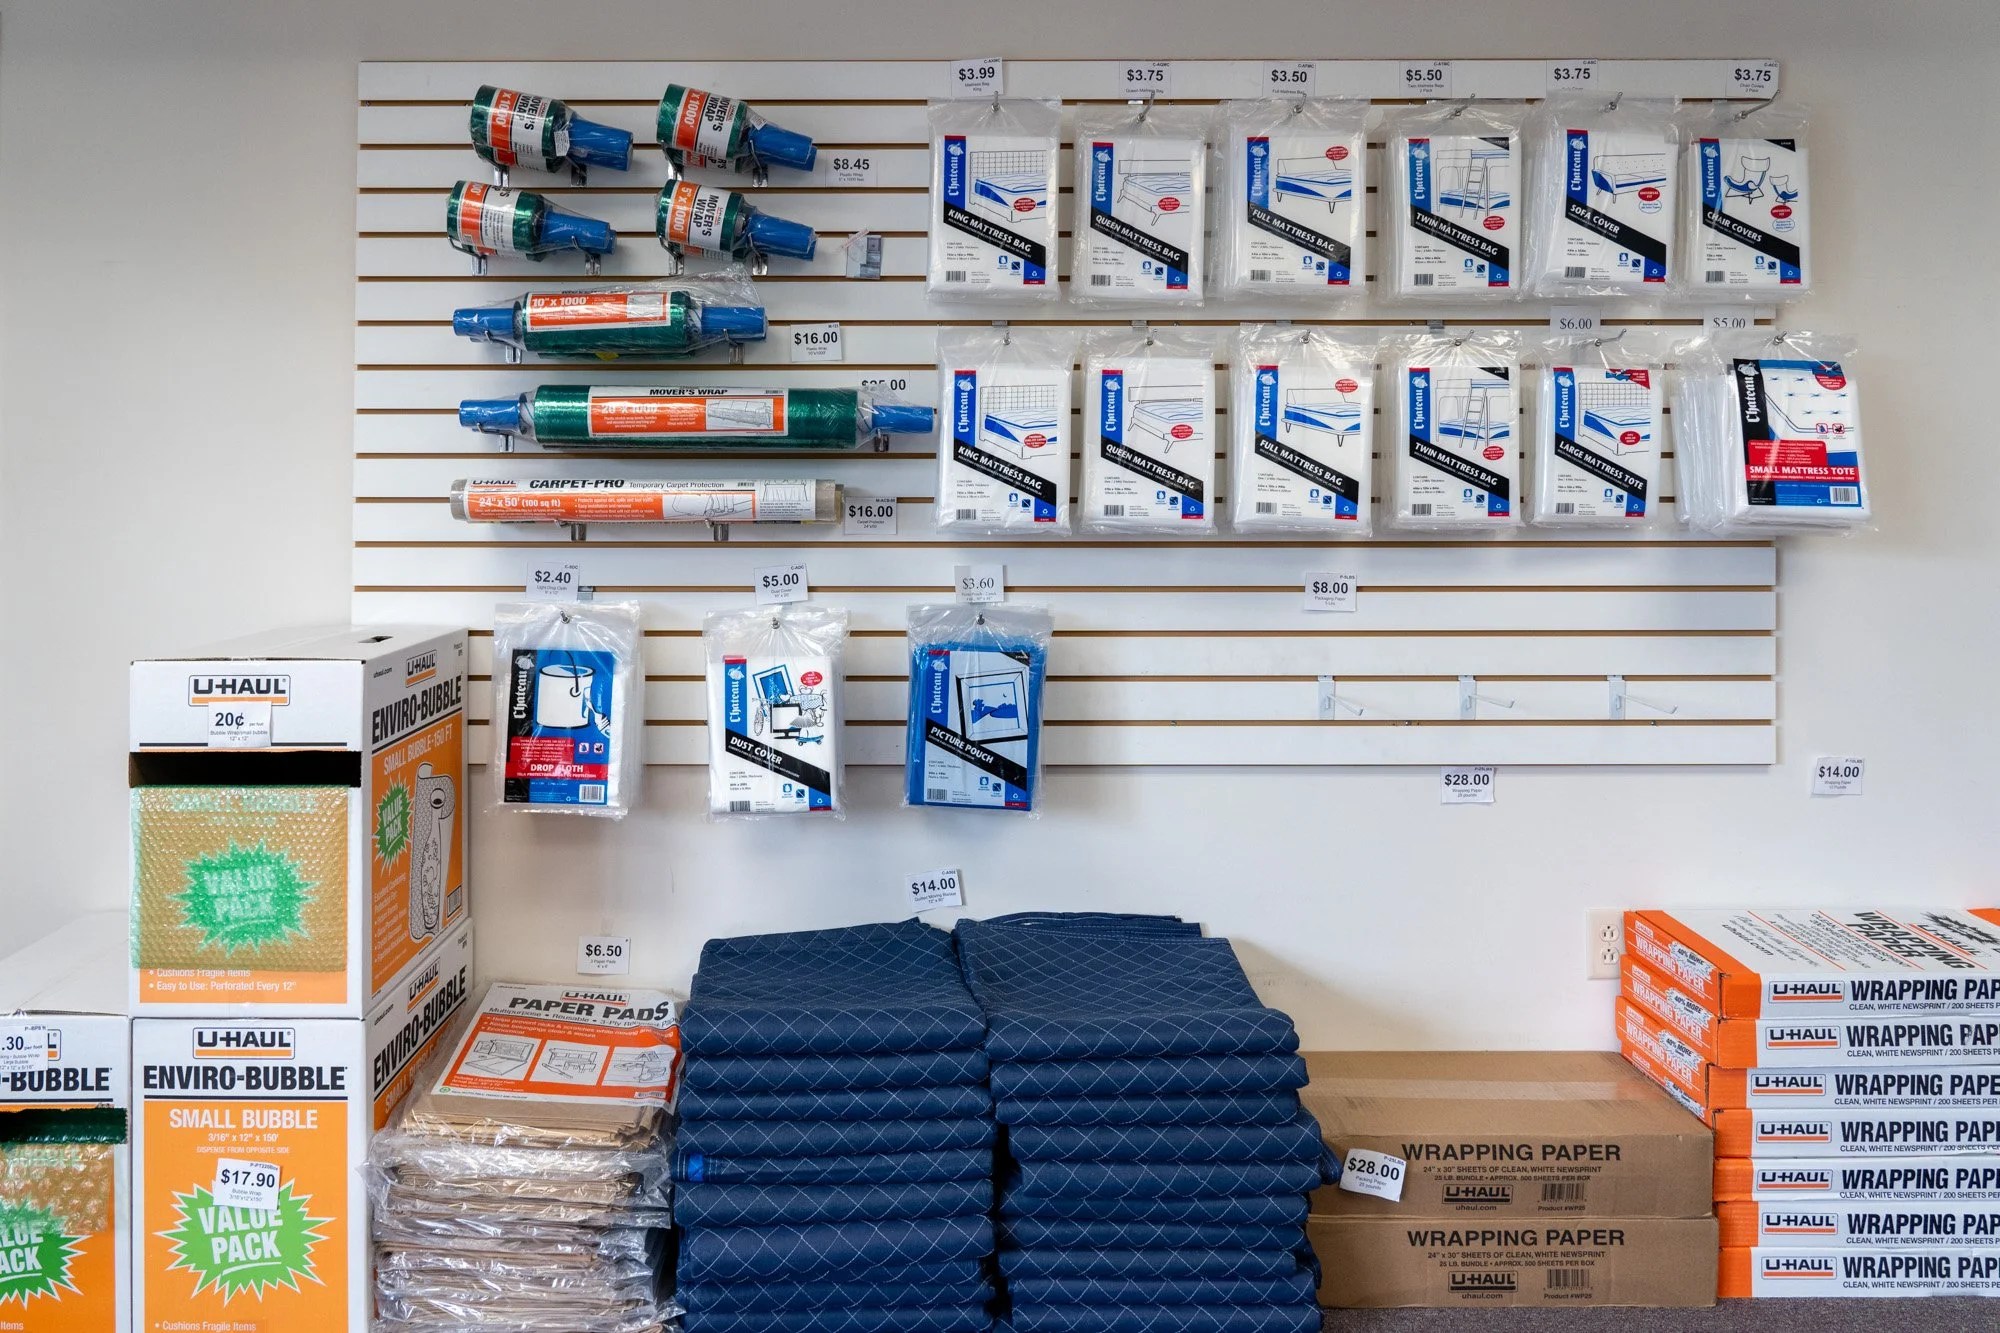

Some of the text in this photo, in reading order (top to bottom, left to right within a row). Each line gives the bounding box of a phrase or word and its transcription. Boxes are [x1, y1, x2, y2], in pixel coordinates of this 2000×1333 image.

[959, 66, 995, 82] $3.99
[1127, 69, 1163, 82] $3.75
[1271, 69, 1307, 83] $3.50
[1406, 69, 1442, 82] $5.50
[1554, 67, 1590, 81] $3.75
[1734, 68, 1771, 81] $3.75
[833, 158, 870, 171] $8.45
[1571, 150, 1582, 191] Chateau
[948, 156, 958, 196] Chateau
[1096, 163, 1106, 202] Chateau
[1252, 158, 1262, 197] Chateau
[1414, 160, 1424, 200] Chateau
[1706, 158, 1714, 198] Chateau
[693, 199, 707, 227] WRAP
[702, 195, 719, 237] MOVER'S
[1570, 204, 1620, 234] SOFA COVER
[948, 208, 1032, 252] KING MATTRESS BAG
[1252, 209, 1335, 252] FULL MATTRESS BAG
[1416, 212, 1498, 256] TWIN MATTRESS BAG
[1707, 211, 1762, 243] CHAIR COVERS
[1095, 215, 1181, 262] QUEEN MATTRESS BAG
[560, 297, 588, 306] 1000'
[1559, 318, 1592, 330] $6.00
[1713, 317, 1746, 329] $5.00
[794, 332, 838, 345] $16.00
[650, 388, 728, 396] MOVER'S WRAP
[1746, 376, 1761, 423] Chateau
[1560, 387, 1569, 428] Chateau
[958, 445, 1043, 491] KING MATTRESS BAG
[1106, 444, 1195, 490] QUEEN MATTRESS BAG
[1260, 439, 1343, 486] FULL MATTRESS BAG
[1415, 441, 1498, 486] TWIN MATTRESS BAG
[1559, 441, 1644, 490] LARGE MATTRESS TOTE
[1750, 466, 1855, 475] SMALL MATTRESS TOTE
[530, 479, 625, 489] CARPET-PRO
[629, 482, 664, 490] Temporary
[848, 506, 893, 518] $16.00
[534, 570, 571, 583] $2.40
[762, 573, 799, 589] $5.00
[962, 578, 994, 590] $3.60
[1312, 581, 1348, 594] $8.00
[407, 654, 436, 676] U-HAUL
[193, 678, 287, 695] U-HAUL
[513, 670, 528, 719] Chateau
[931, 672, 942, 714] Chateau
[372, 675, 461, 745] ENVIRO-BUBBLE
[730, 681, 741, 723] Chateau
[215, 712, 244, 729] 20¢
[730, 736, 783, 765] DUST COVER
[931, 726, 994, 764] PICTURE POUCH
[531, 763, 584, 773] DROP CLOTH
[1818, 765, 1860, 779] $14.00
[1444, 774, 1489, 787] $28.00
[382, 793, 403, 823] VALUE
[385, 817, 402, 847] PACK
[912, 877, 956, 896] $14.00
[585, 944, 622, 957] $6.50
[1845, 923, 1925, 959] PAPER
[1853, 912, 1975, 969] WRAPPING
[1635, 934, 1705, 993] WRAPPING PAPER
[157, 982, 177, 992] Easy
[179, 982, 188, 991] to
[189, 982, 208, 991] Use:
[211, 982, 254, 991] Perforated
[256, 982, 280, 992] Every
[409, 963, 439, 1000] U-HAUL
[1773, 984, 1841, 995] U-HAUL
[1851, 979, 1958, 1001] WRAPPING
[564, 991, 626, 1002] U-HAUL
[1878, 1003, 1901, 1011] WHITE
[489, 1007, 542, 1017] Multipurpose
[552, 1013, 590, 1023] Reusable
[509, 997, 669, 1022] PAPER PADS
[197, 1031, 291, 1047] U-HAUL
[374, 968, 466, 1092] ENVIRO-BUBBLE
[1846, 1025, 1951, 1047] WRAPPING
[143, 1065, 345, 1090] ENVIRO-BUBBLE
[1835, 1074, 1942, 1096] WRAPPING
[169, 1109, 318, 1129] SMALL BUBBLE
[1401, 1143, 1621, 1161] WRAPPING PAPER
[220, 1168, 275, 1188] $17.90
[1348, 1156, 1400, 1181] $28.00
[1457, 1166, 1488, 1174] SHEETS
[1489, 1166, 1500, 1174] OF
[1501, 1166, 1529, 1175] CLEAN,
[1530, 1166, 1555, 1174] WHITE
[1556, 1166, 1602, 1174] NEWSPRINT
[1842, 1169, 1948, 1190] WRAPPING
[1446, 1187, 1510, 1197] U-HAUL
[198, 1205, 283, 1234] VALUE
[211, 1230, 281, 1264] PACK
[1407, 1229, 1625, 1247] WRAPPING PAPER
[1452, 1274, 1515, 1284] U-HAUL
[1843, 1257, 1950, 1279] WRAPPING
[0, 1321, 24, 1330] Items
[163, 1321, 256, 1332] Cushions Fragile Items
